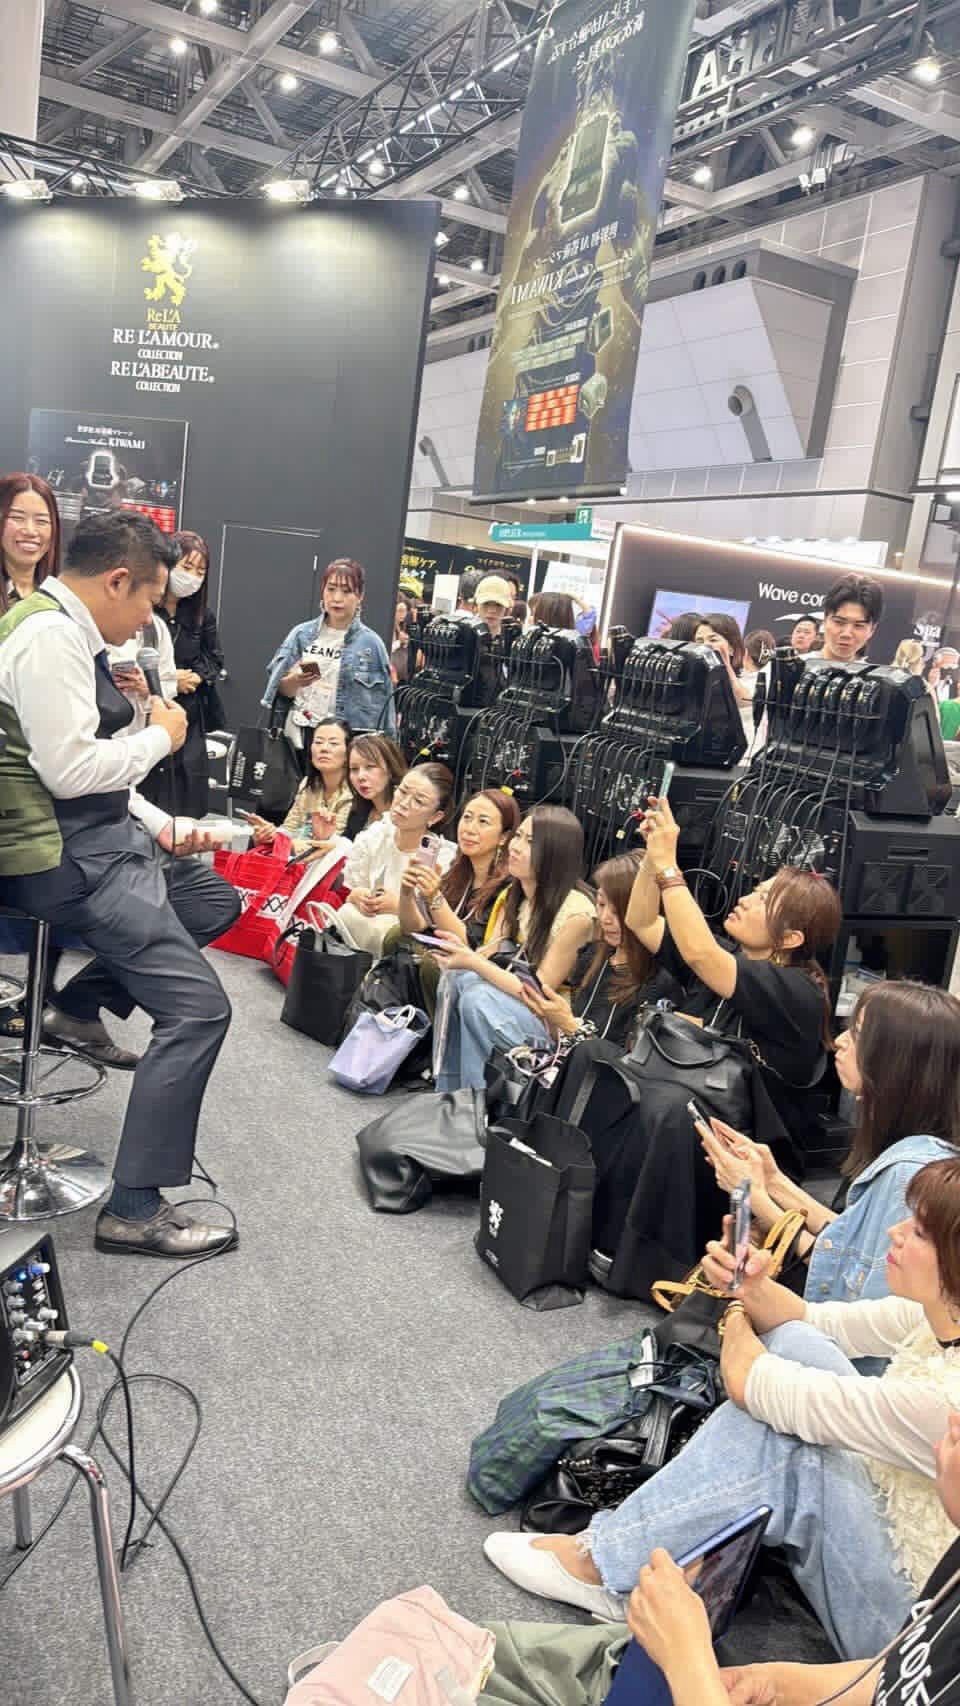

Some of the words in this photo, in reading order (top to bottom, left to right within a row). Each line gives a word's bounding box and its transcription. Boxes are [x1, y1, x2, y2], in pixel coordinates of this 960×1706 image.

[112, 327, 136, 344] RE
[137, 348, 183, 361] COLLECTION
[135, 380, 181, 393] COLLECTION
[758, 582, 798, 604] Wave
